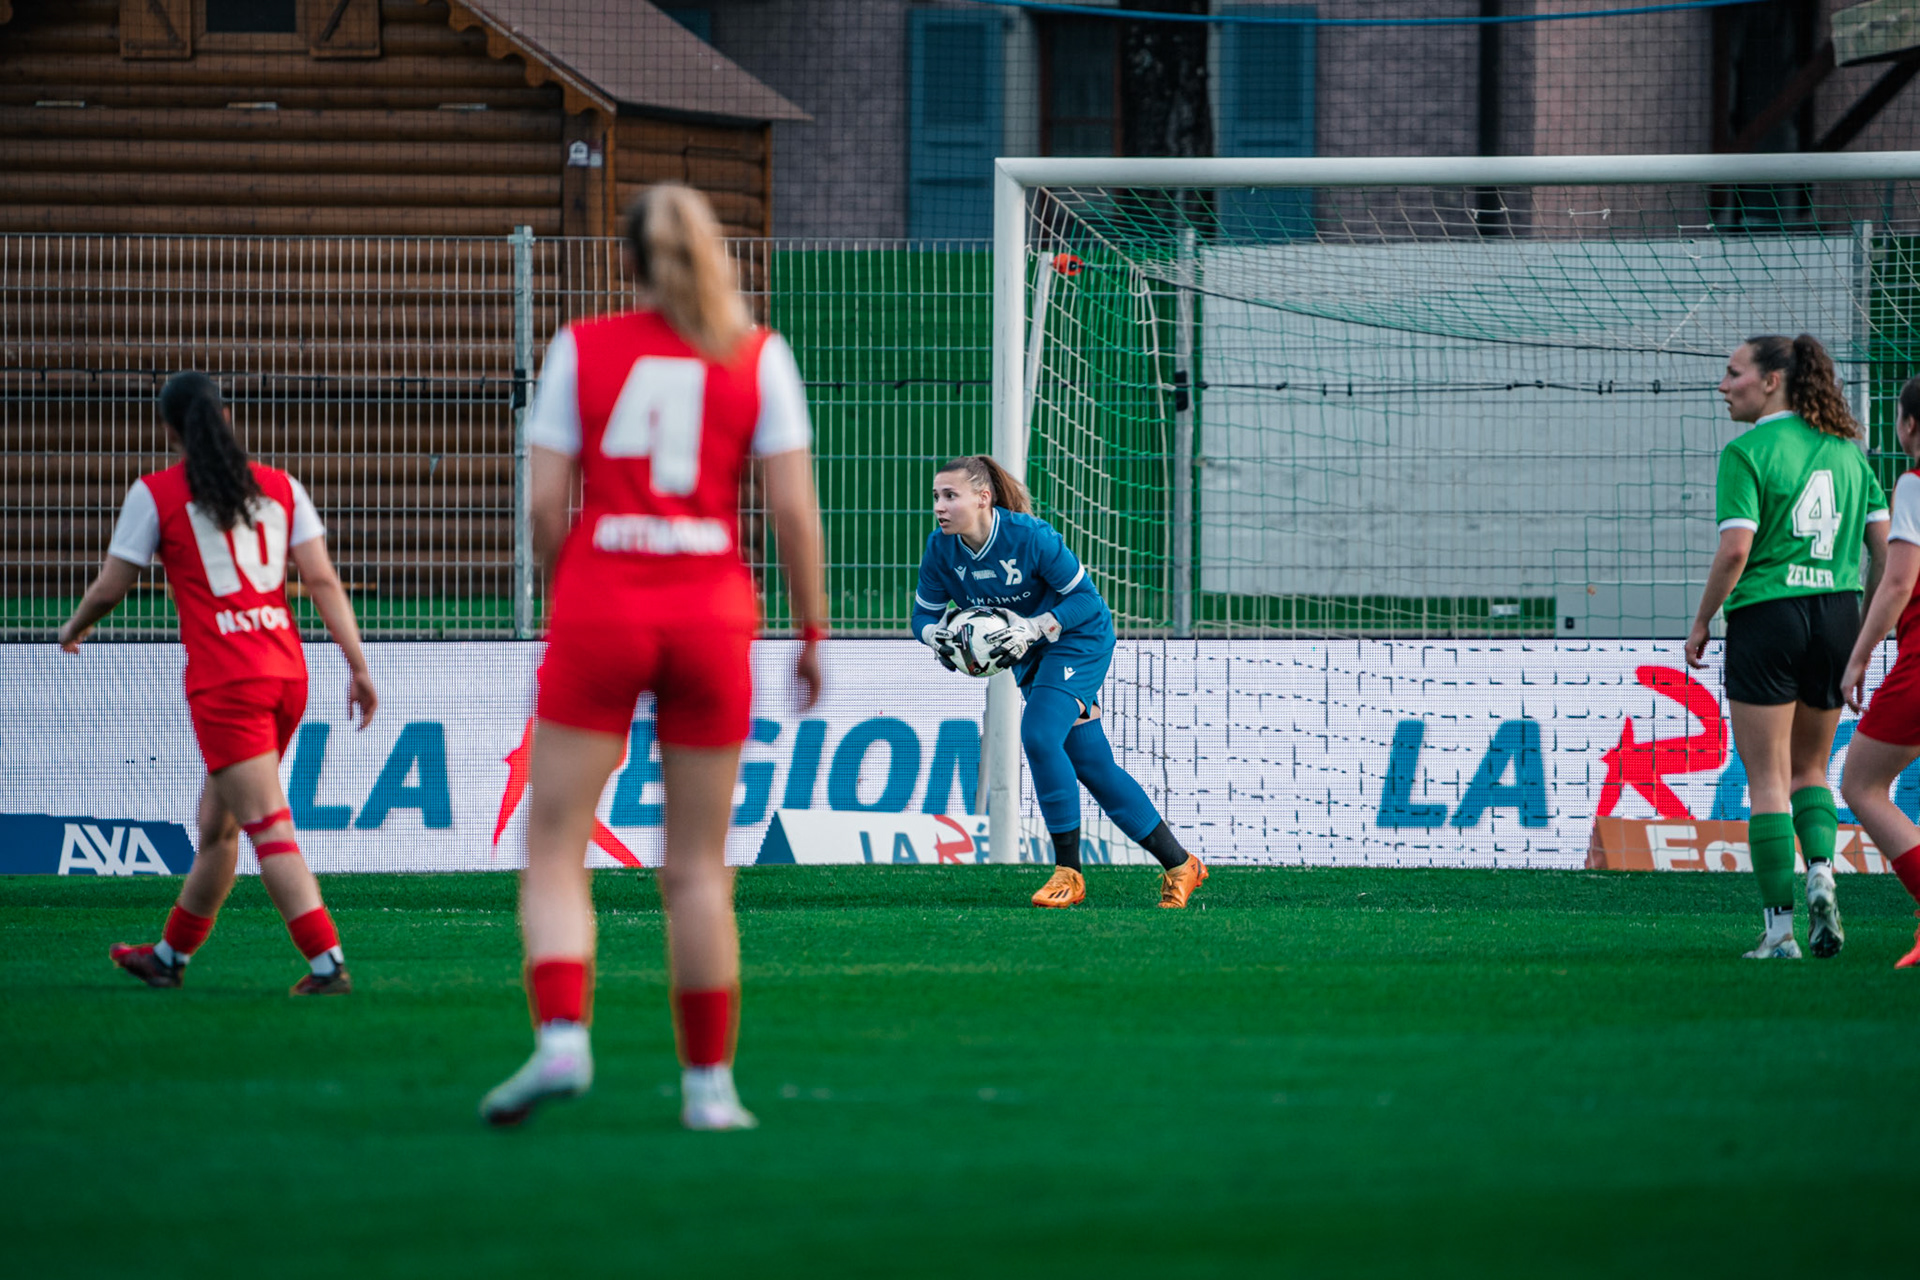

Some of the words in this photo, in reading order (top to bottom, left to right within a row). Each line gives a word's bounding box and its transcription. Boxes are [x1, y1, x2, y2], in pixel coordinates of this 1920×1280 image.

[601, 355, 708, 496] 4
[185, 496, 289, 598] 10
[1791, 469, 1842, 560] 4
[1785, 562, 1835, 589] ZELLER
[287, 721, 453, 830] LA
[1375, 719, 1549, 828] LA
[57, 822, 173, 876] AXA
